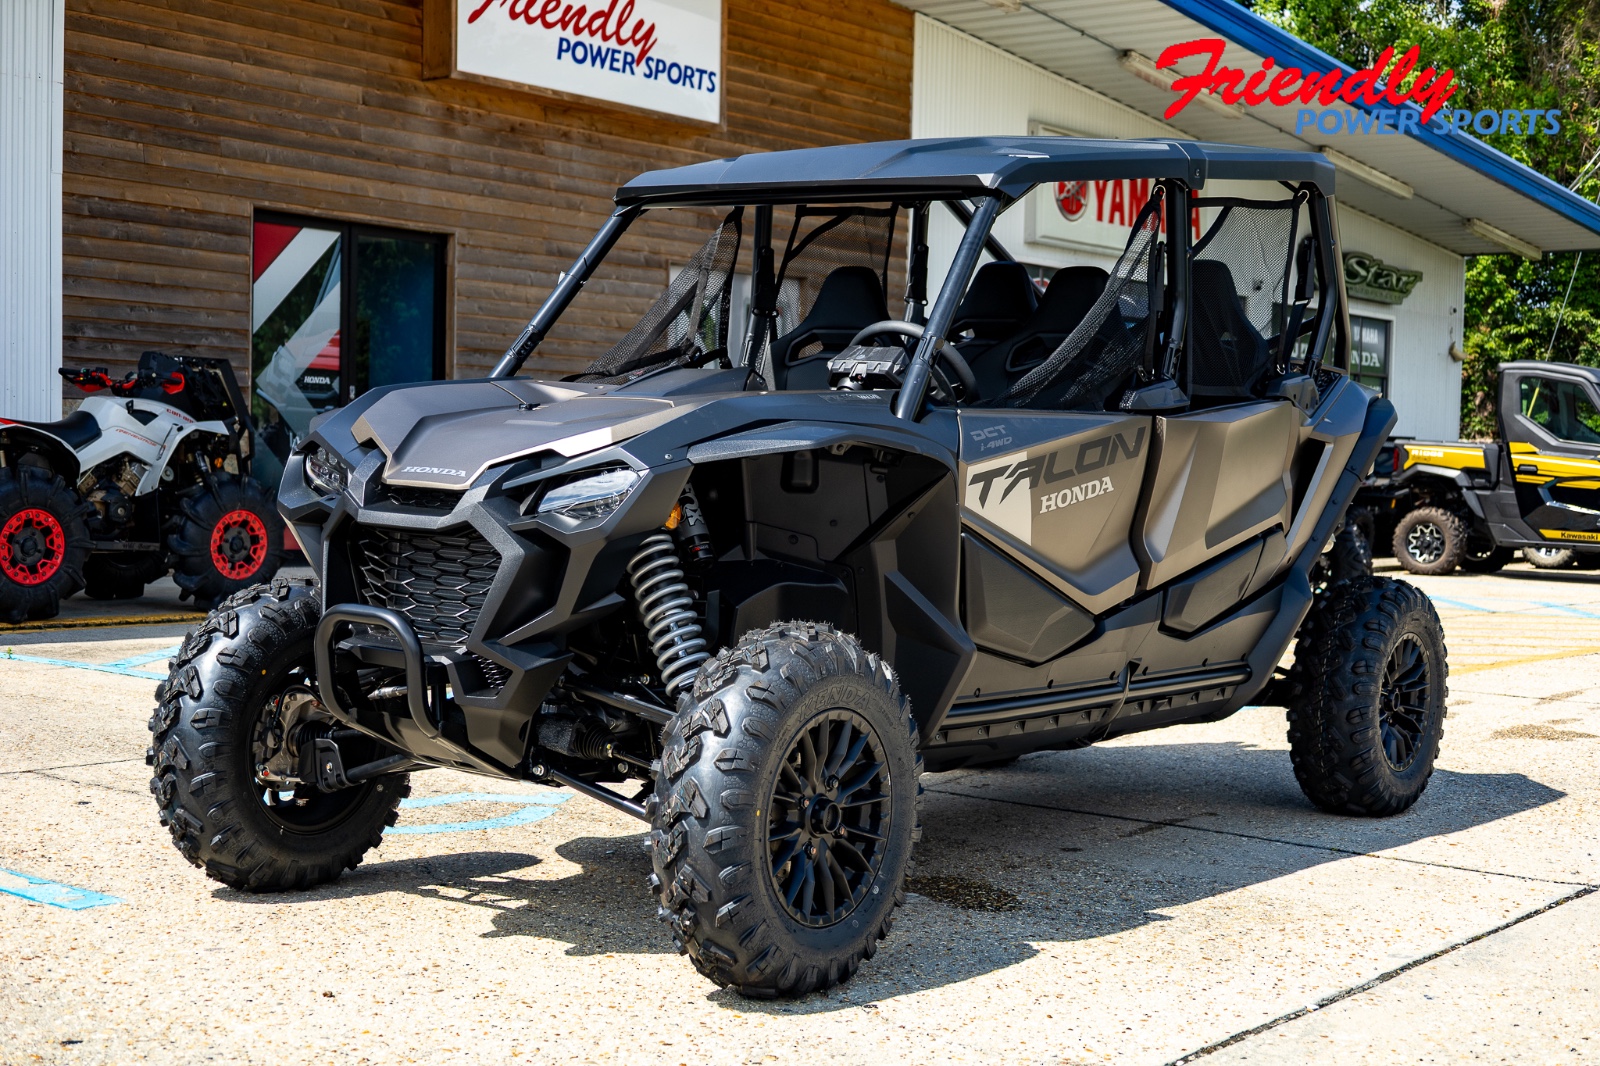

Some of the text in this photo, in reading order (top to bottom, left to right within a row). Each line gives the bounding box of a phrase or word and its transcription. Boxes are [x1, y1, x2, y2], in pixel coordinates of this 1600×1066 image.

[467, 0, 657, 67] riendly
[556, 37, 717, 94] POWER SPORTS
[1344, 256, 1417, 293] Star
[303, 375, 331, 385] HONDA
[970, 425, 1006, 441] DCT
[401, 466, 467, 478] HONDA
[968, 426, 1147, 509] TALON
[1039, 476, 1115, 514] HONDA
[1560, 531, 1599, 540] Kawasaki
[798, 683, 871, 721] KENDA
